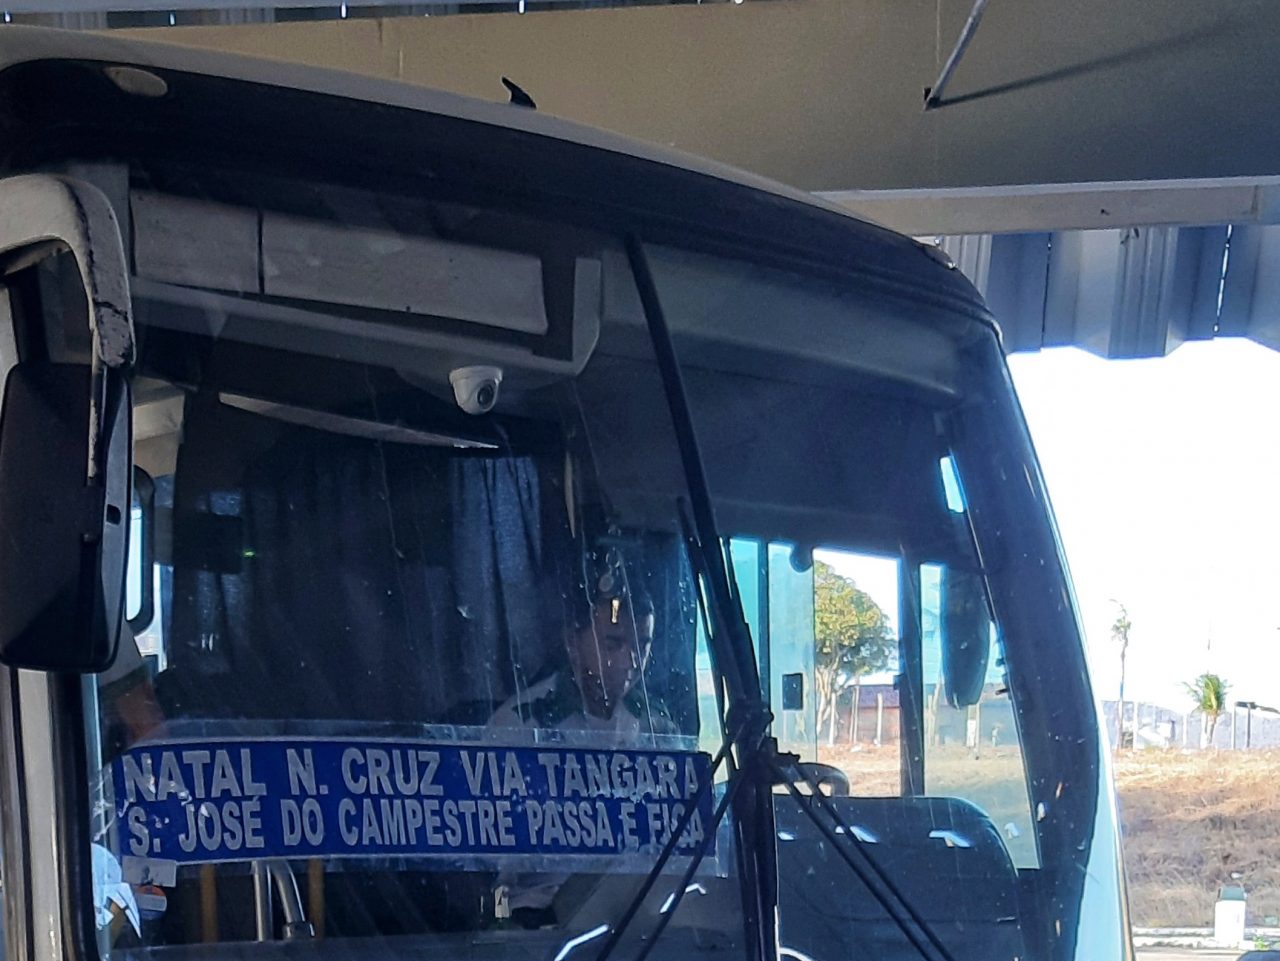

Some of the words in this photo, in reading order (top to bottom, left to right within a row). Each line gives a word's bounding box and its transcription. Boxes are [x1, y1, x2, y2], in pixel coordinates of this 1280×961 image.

[121, 748, 267, 801] NATAL
[286, 748, 329, 796] N.
[341, 747, 444, 796] CRUZ
[459, 750, 527, 797] VIA
[537, 751, 700, 799] TANGARA
[178, 795, 265, 851] JOSÉ
[280, 798, 324, 847] DO
[338, 798, 516, 847] CAMPESTRE
[526, 800, 615, 848] PASSA
[620, 802, 640, 850] E
